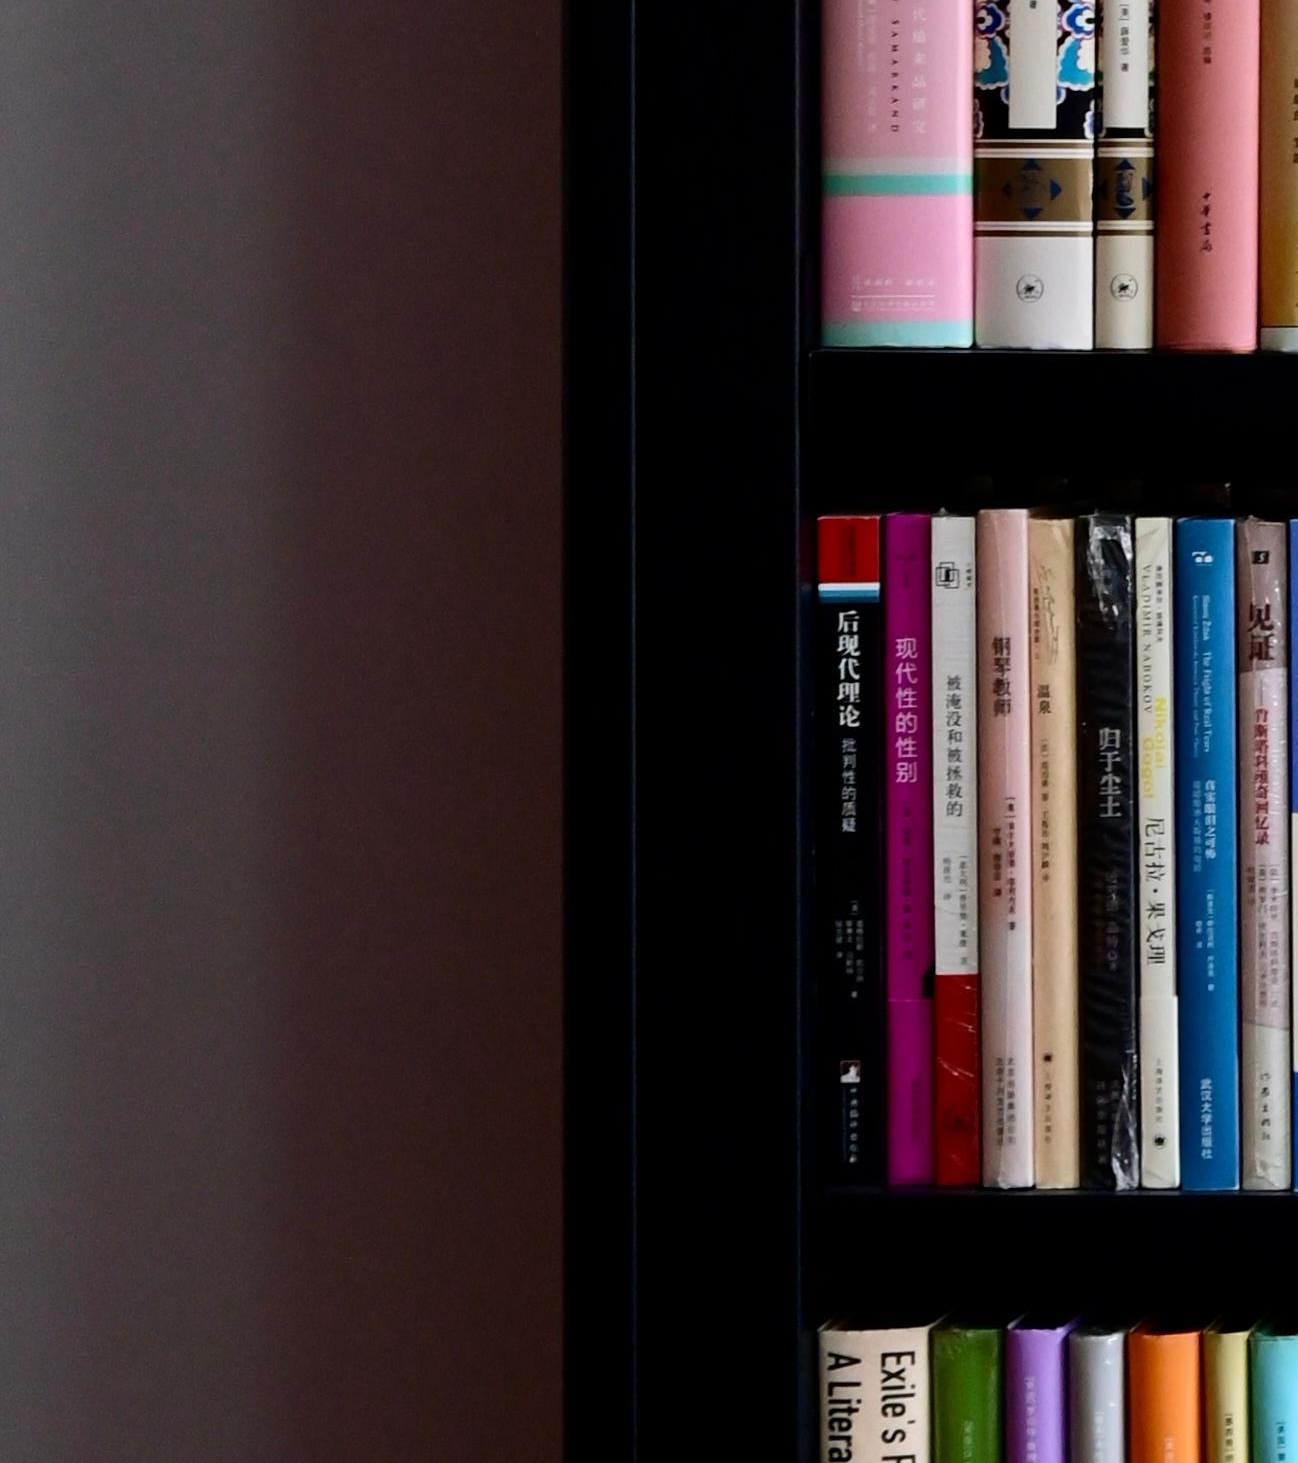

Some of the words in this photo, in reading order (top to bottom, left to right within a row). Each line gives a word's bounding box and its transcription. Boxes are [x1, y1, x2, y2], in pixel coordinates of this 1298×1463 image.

[837, 609, 861, 728] 后现代理论
[895, 637, 918, 784] 现代性的性别
[827, 1352, 861, 1371] A
[881, 1351, 916, 1444] Exile's
